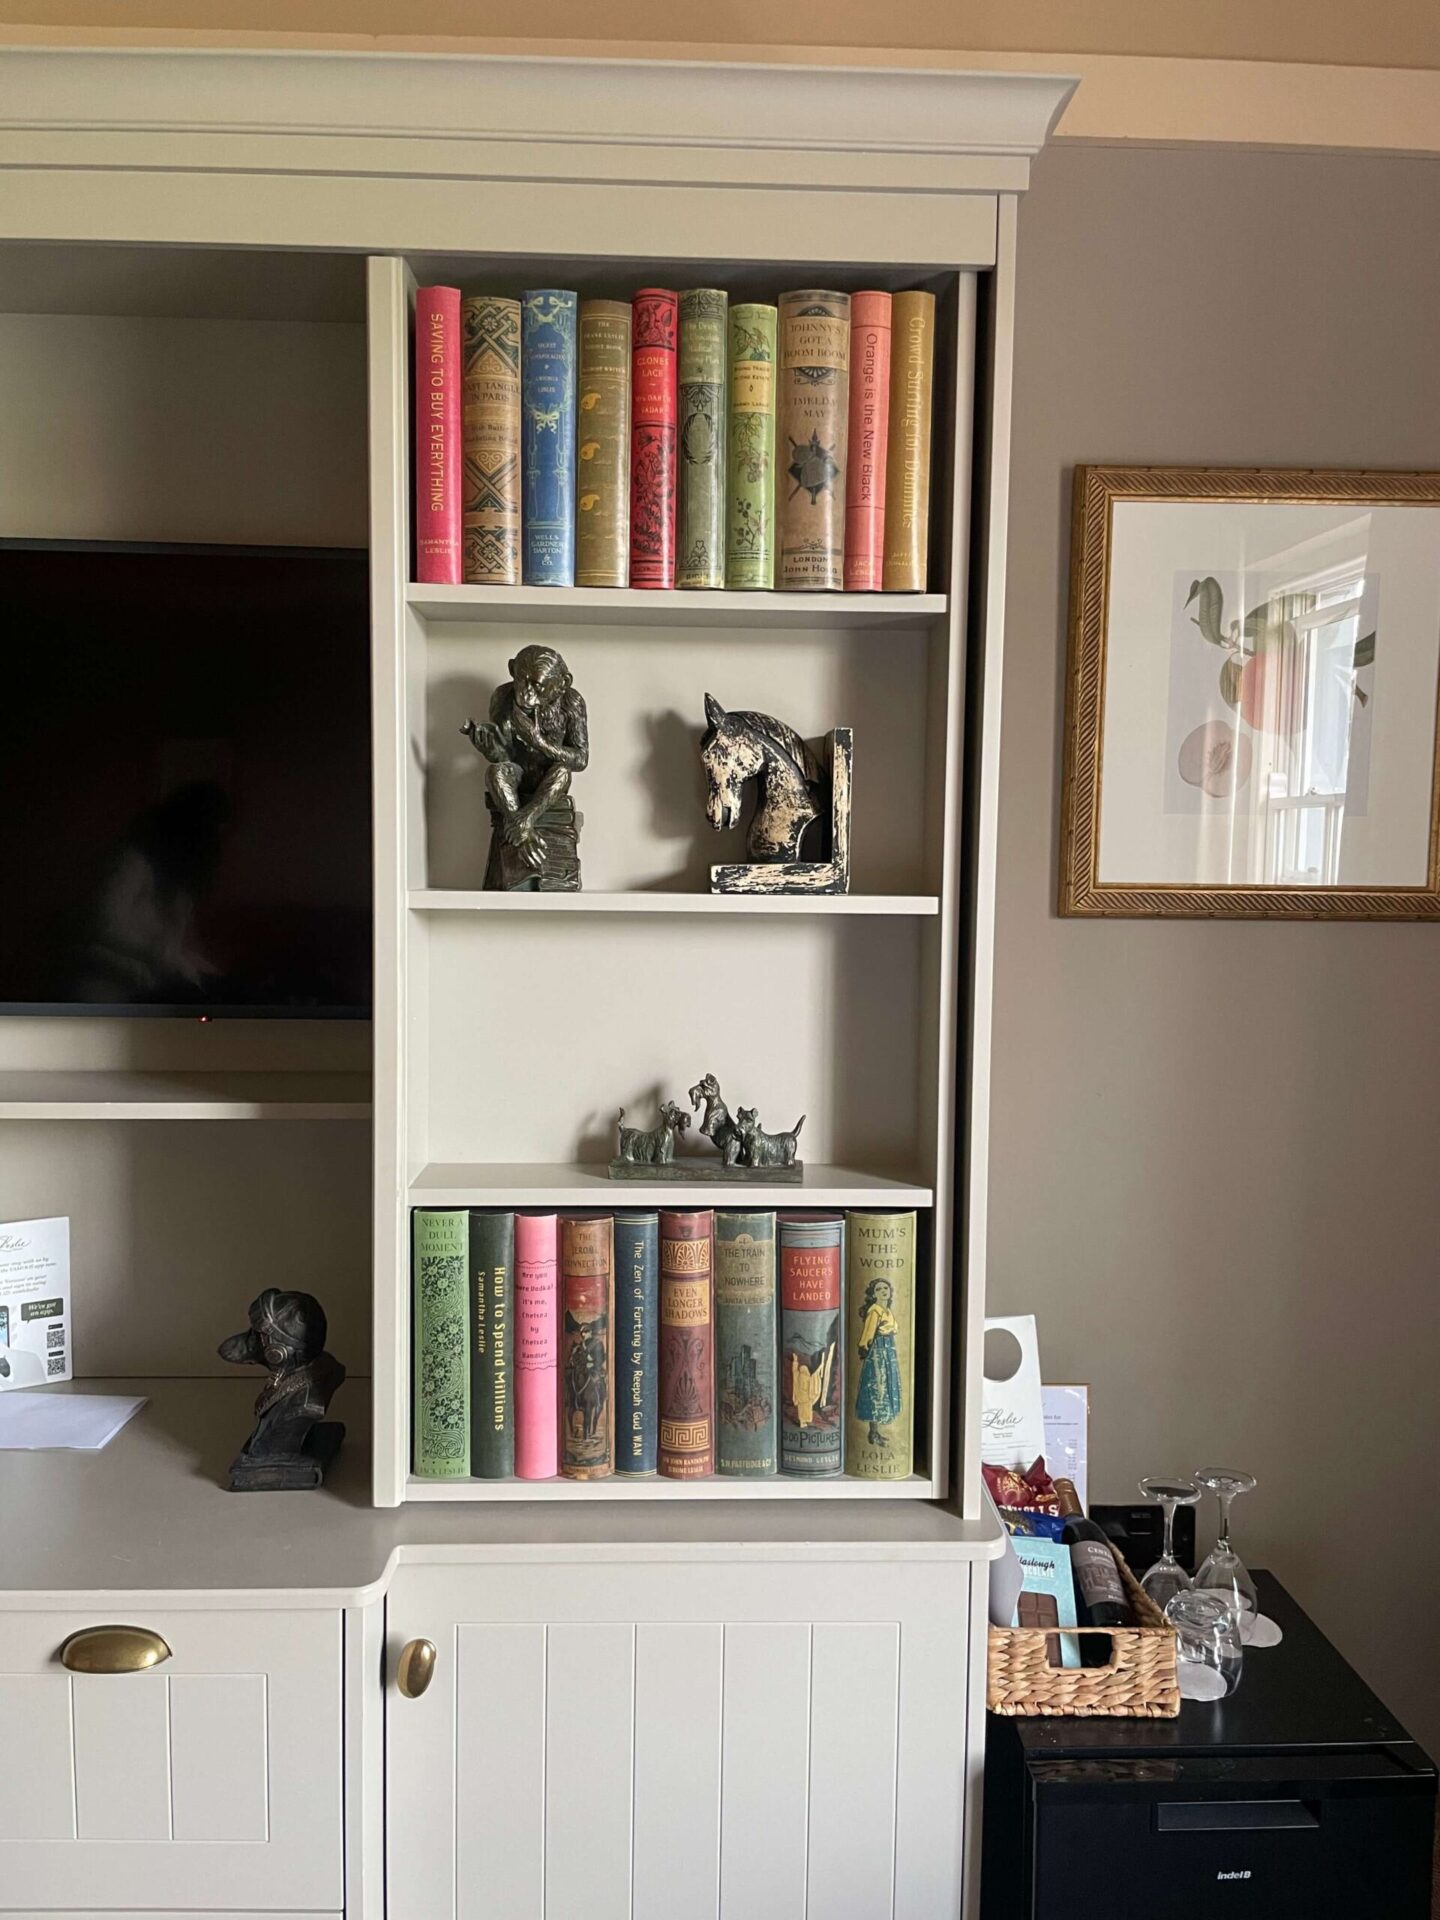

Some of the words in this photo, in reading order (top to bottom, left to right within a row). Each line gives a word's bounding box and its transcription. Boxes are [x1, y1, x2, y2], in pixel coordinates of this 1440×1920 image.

[791, 324, 841, 334] JOHNNY'S
[431, 313, 444, 364] SAVING
[799, 336, 821, 345] GOT
[825, 337, 832, 345] A
[908, 317, 926, 364] Crowd
[636, 356, 669, 366] CLONES
[784, 349, 814, 359] BOOM
[817, 349, 846, 361] BOOM
[862, 332, 878, 383] Orange
[431, 369, 444, 387] TO
[642, 369, 665, 377] LACE
[864, 388, 877, 399] is
[901, 370, 925, 426] Surfing
[430, 392, 444, 420] BUY
[793, 397, 837, 406] IMELDA
[803, 410, 826, 418] MAY
[863, 405, 876, 424] the
[863, 430, 875, 459] New
[904, 433, 922, 452] for
[430, 424, 444, 512] EVERYTHING
[861, 464, 873, 501] Black
[902, 460, 920, 529] Dummies
[784, 564, 808, 573] JOHN
[421, 1218, 455, 1228] NEVER
[458, 1217, 464, 1227] A
[428, 1231, 457, 1240] DULL
[858, 1227, 906, 1239] MUM'S
[420, 1243, 464, 1252] MOMENT
[633, 1241, 645, 1259] The
[724, 1248, 740, 1258] THE
[740, 1248, 766, 1258] TRAIN
[867, 1243, 898, 1254] THE
[793, 1255, 830, 1266] FLYING
[859, 1258, 905, 1269] WORD
[739, 1262, 751, 1272] TO
[790, 1267, 833, 1277] SAUCERS
[534, 1272, 548, 1280] you
[633, 1265, 645, 1283] Zen
[494, 1266, 506, 1297] How
[724, 1275, 766, 1287] NOWHERE
[799, 1279, 824, 1289] HAVE
[478, 1271, 486, 1320] Samantha
[633, 1288, 645, 1300] of
[673, 1287, 698, 1297] EVEN
[792, 1292, 831, 1301] LANDED
[668, 1297, 704, 1308] LONGER
[494, 1304, 506, 1318] to
[664, 1308, 708, 1318] SHADOWS
[631, 1306, 644, 1347] Farting
[478, 1323, 486, 1353] Leslie
[492, 1323, 506, 1366] Spend
[631, 1352, 644, 1365] by
[631, 1370, 643, 1407] Reepah
[494, 1371, 506, 1431] Millions
[632, 1411, 643, 1430] Gud
[632, 1435, 643, 1456] WAN
[861, 1451, 896, 1461] LOLA
[856, 1464, 901, 1475] LESLIE
[1017, 1555, 1056, 1572] laslough
